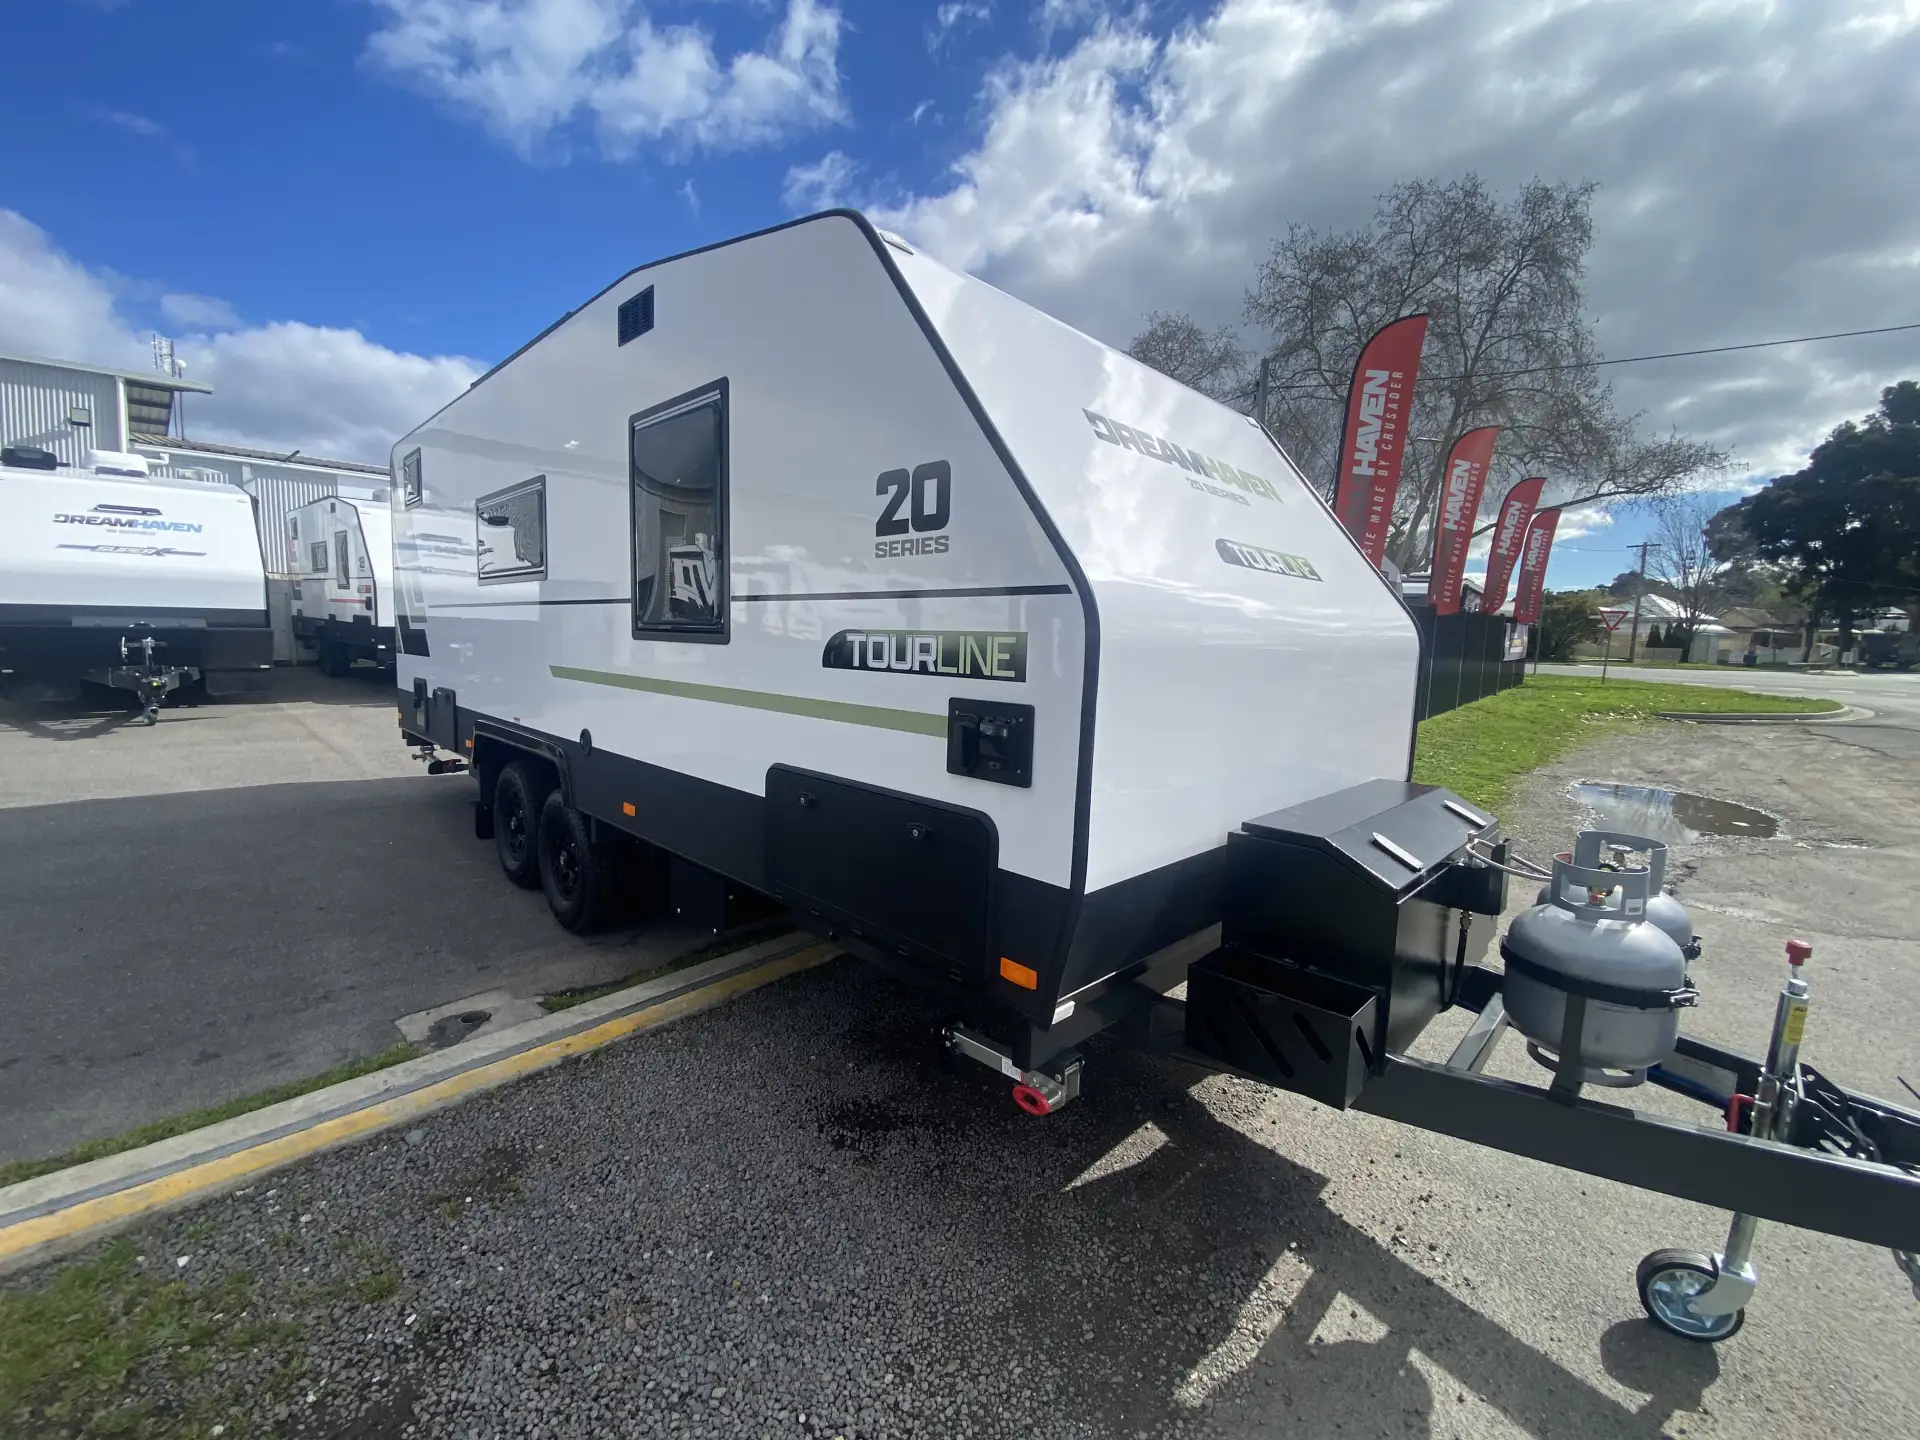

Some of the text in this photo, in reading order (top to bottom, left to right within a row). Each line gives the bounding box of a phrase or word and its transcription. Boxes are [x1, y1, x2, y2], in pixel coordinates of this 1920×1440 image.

[1352, 369, 1390, 476] HAVEN
[1381, 371, 1404, 450] CRUSADER
[1082, 408, 1285, 505] DREAMHAVEN
[1377, 459, 1390, 476] BY
[875, 459, 951, 537] 20
[1202, 482, 1251, 506] SERIES
[1370, 485, 1386, 523] MADE
[1443, 459, 1472, 531] HAVEN
[1463, 462, 1480, 514] CRUSADER
[53, 513, 203, 533] DREAMHAVEN
[1496, 500, 1522, 555] HAVEN
[874, 535, 950, 559] SERIES
[1224, 540, 1320, 580] TOURLINE
[1525, 527, 1545, 572] HAVEN
[845, 632, 1018, 678] TOURLINE
